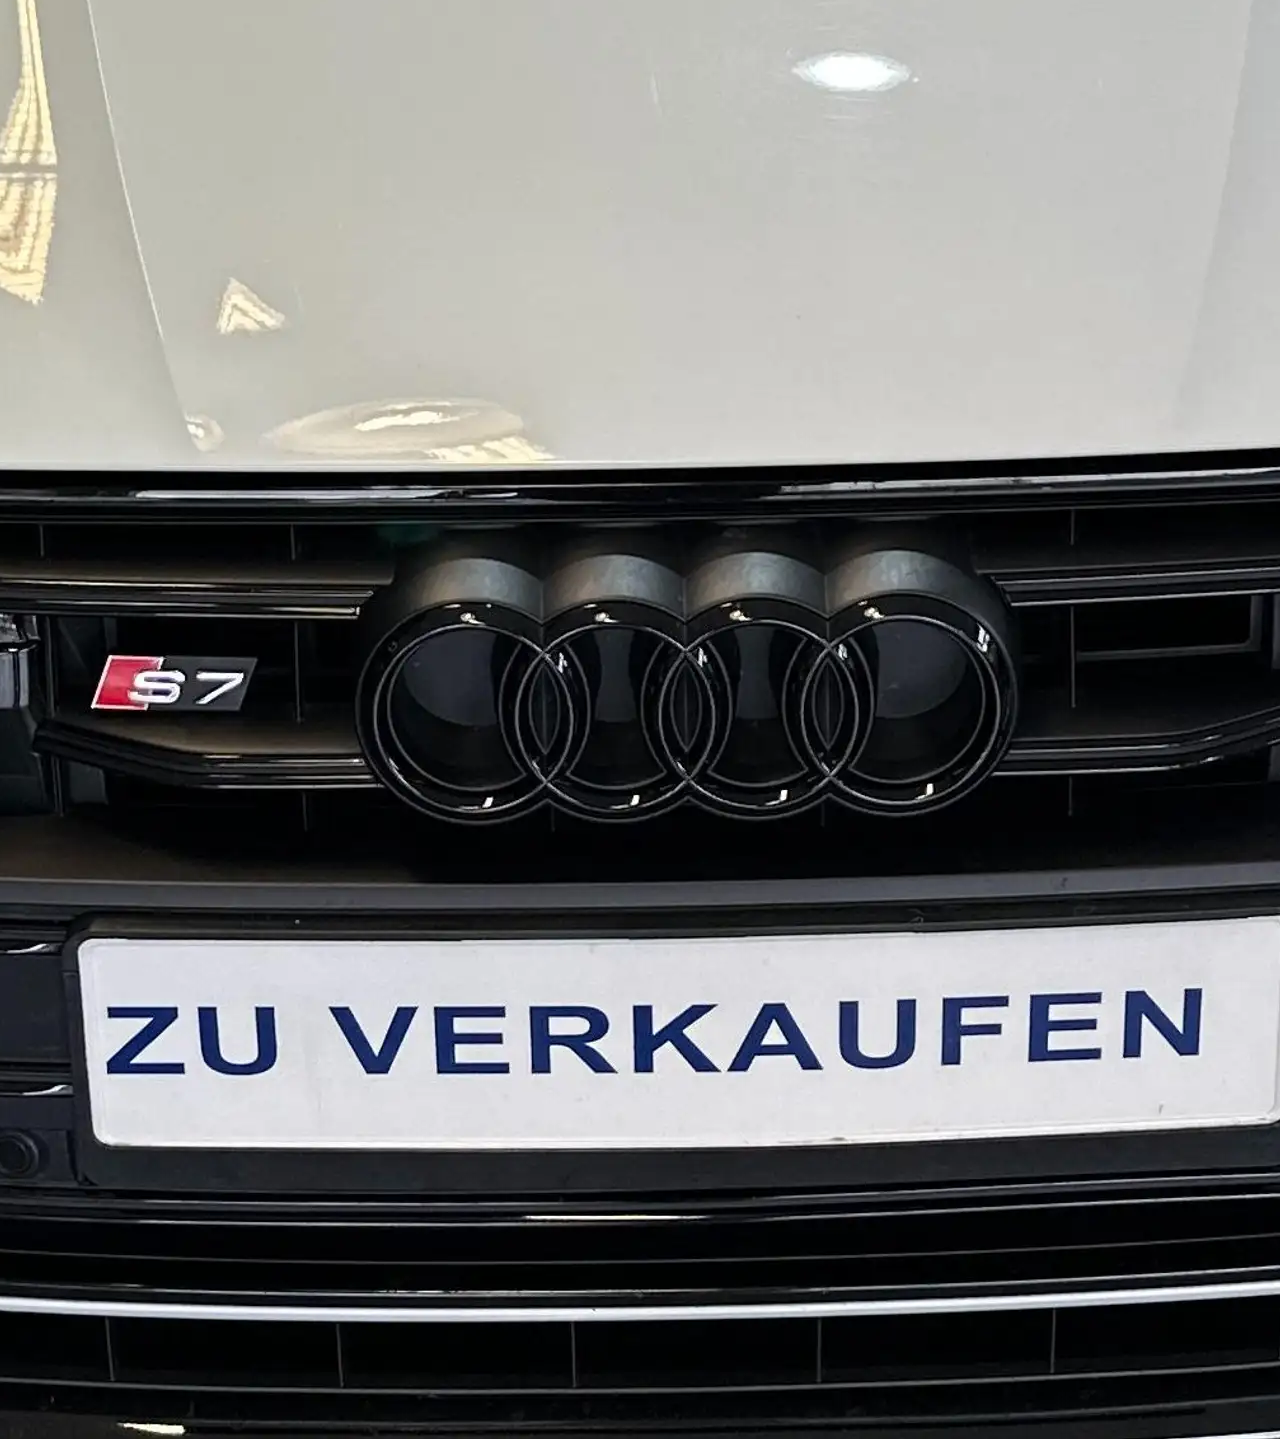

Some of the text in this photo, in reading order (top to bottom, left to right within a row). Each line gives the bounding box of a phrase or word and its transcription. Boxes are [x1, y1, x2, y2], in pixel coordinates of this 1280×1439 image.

[128, 670, 243, 704] S7
[108, 990, 1201, 1074] ZU VERKAUFEN
